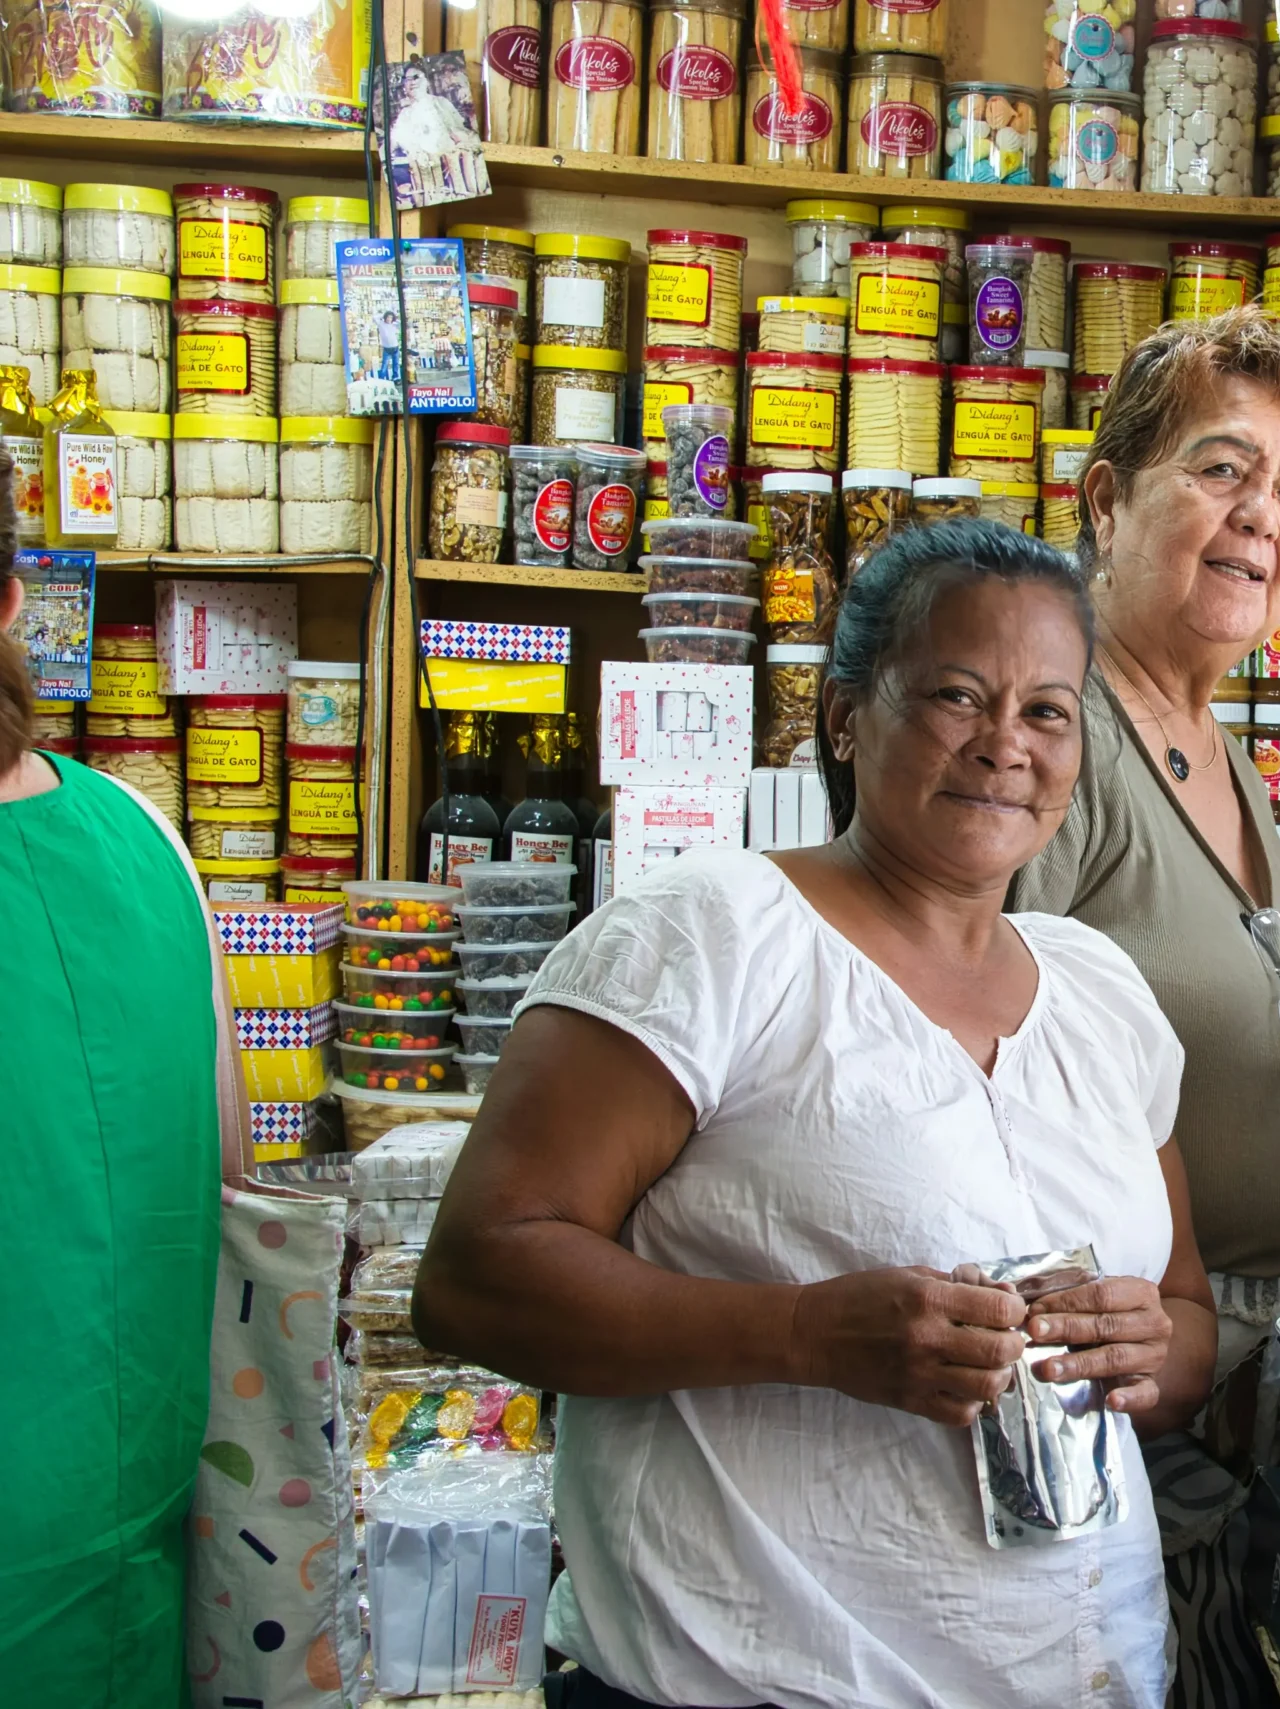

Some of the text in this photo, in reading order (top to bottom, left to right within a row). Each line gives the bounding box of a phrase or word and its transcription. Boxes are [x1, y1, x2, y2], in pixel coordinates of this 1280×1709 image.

[238, 253, 263, 264] GATO
[876, 281, 926, 300] Didang's
[662, 294, 703, 306] DE GATO
[860, 305, 937, 320] LENGUA DE GATO
[199, 364, 243, 374] DE GATO
[412, 388, 450, 397] Tayo Na!
[768, 393, 819, 416] Didang's
[969, 406, 1019, 424] Didang's
[754, 417, 831, 430] LENGUA DE GATO
[956, 430, 1032, 442] LENGUA DE GATO
[17, 456, 40, 466] Honey
[81, 455, 106, 464] Honey
[95, 664, 146, 682] Didang's
[41, 680, 72, 688] Tayo Na!
[119, 690, 132, 698] DE
[192, 732, 239, 750] Didang's
[212, 757, 257, 766] DE GATO
[301, 786, 352, 802] Didang's
[291, 808, 339, 819] LENGUA DE
[435, 840, 488, 852] Hney Bee
[516, 838, 568, 849] Honey Bee
